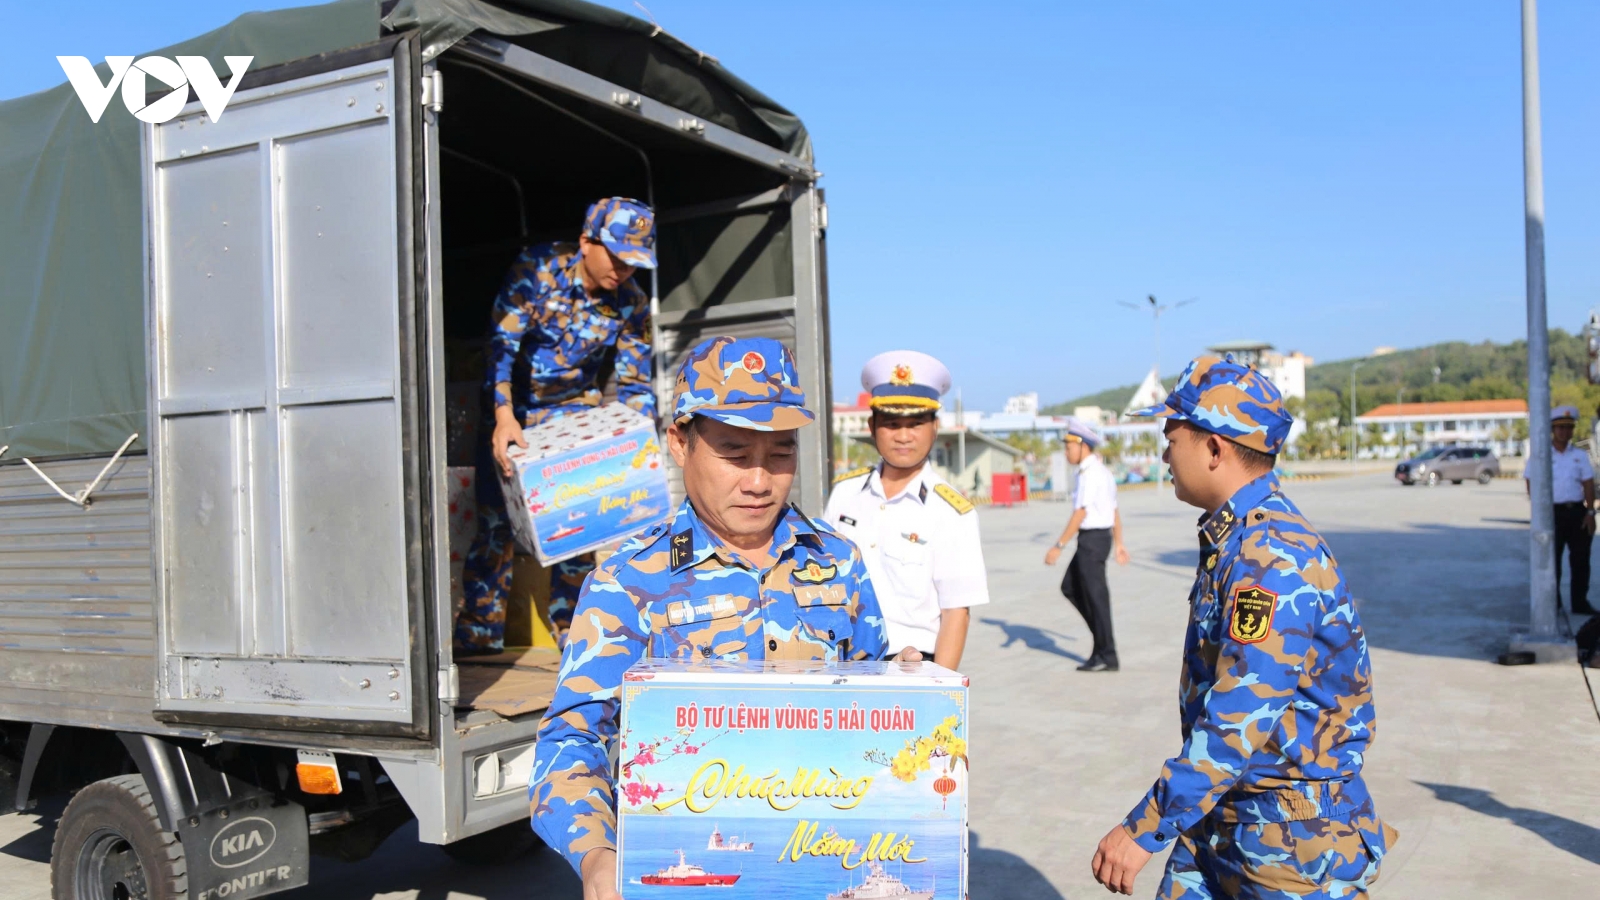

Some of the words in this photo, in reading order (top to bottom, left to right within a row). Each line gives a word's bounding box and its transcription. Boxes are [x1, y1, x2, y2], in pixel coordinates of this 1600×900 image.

[676, 702, 698, 733] BỘ
[703, 705, 725, 729] TƯ
[728, 703, 770, 734] LỆNH
[775, 703, 818, 730] VÙNG
[823, 709, 833, 730] 5
[838, 702, 865, 730] HẢI
[870, 705, 914, 733] QUÂN
[652, 758, 800, 813] Chúc
[783, 766, 874, 810] Mừng
[222, 830, 264, 857] KIA
[777, 819, 864, 870] Năm
[863, 832, 928, 864] Mới
